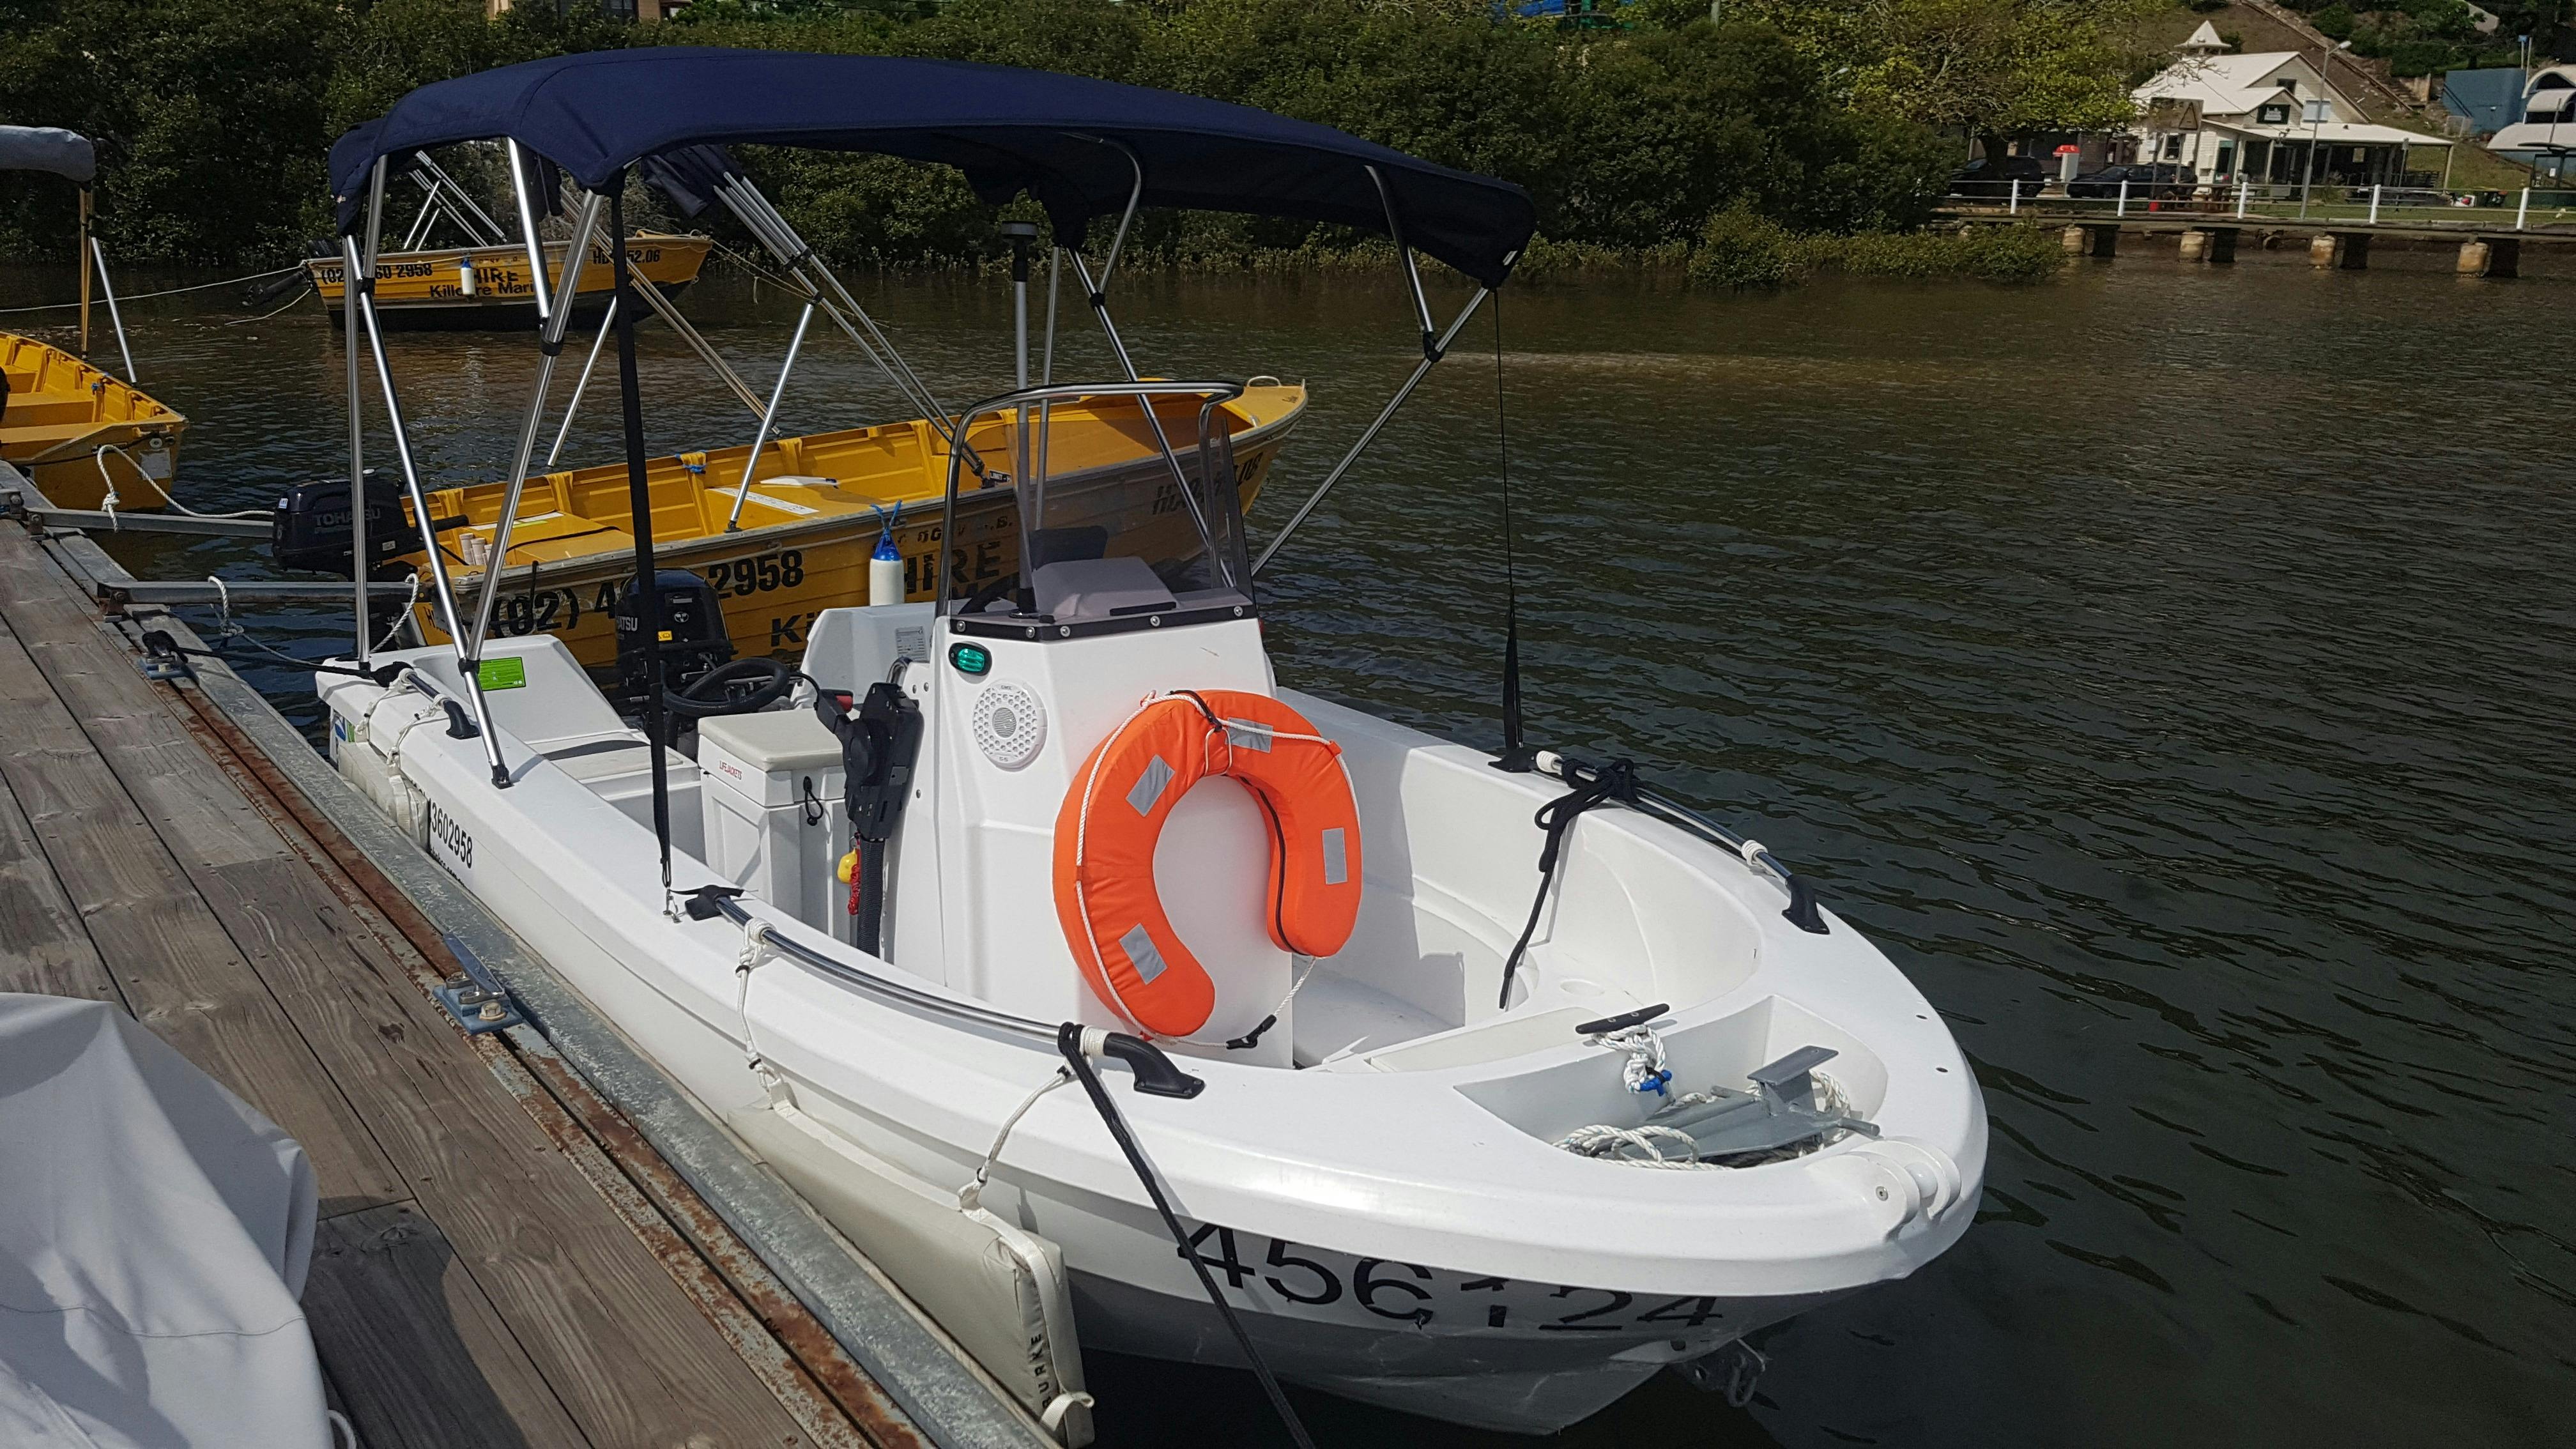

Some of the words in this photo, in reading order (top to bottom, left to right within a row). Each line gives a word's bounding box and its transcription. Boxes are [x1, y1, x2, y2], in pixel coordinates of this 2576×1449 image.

[396, 263, 433, 278] 2958
[430, 284, 492, 298] Killcre
[708, 550, 804, 599] 2958
[1177, 1223, 1724, 1330] 456124
